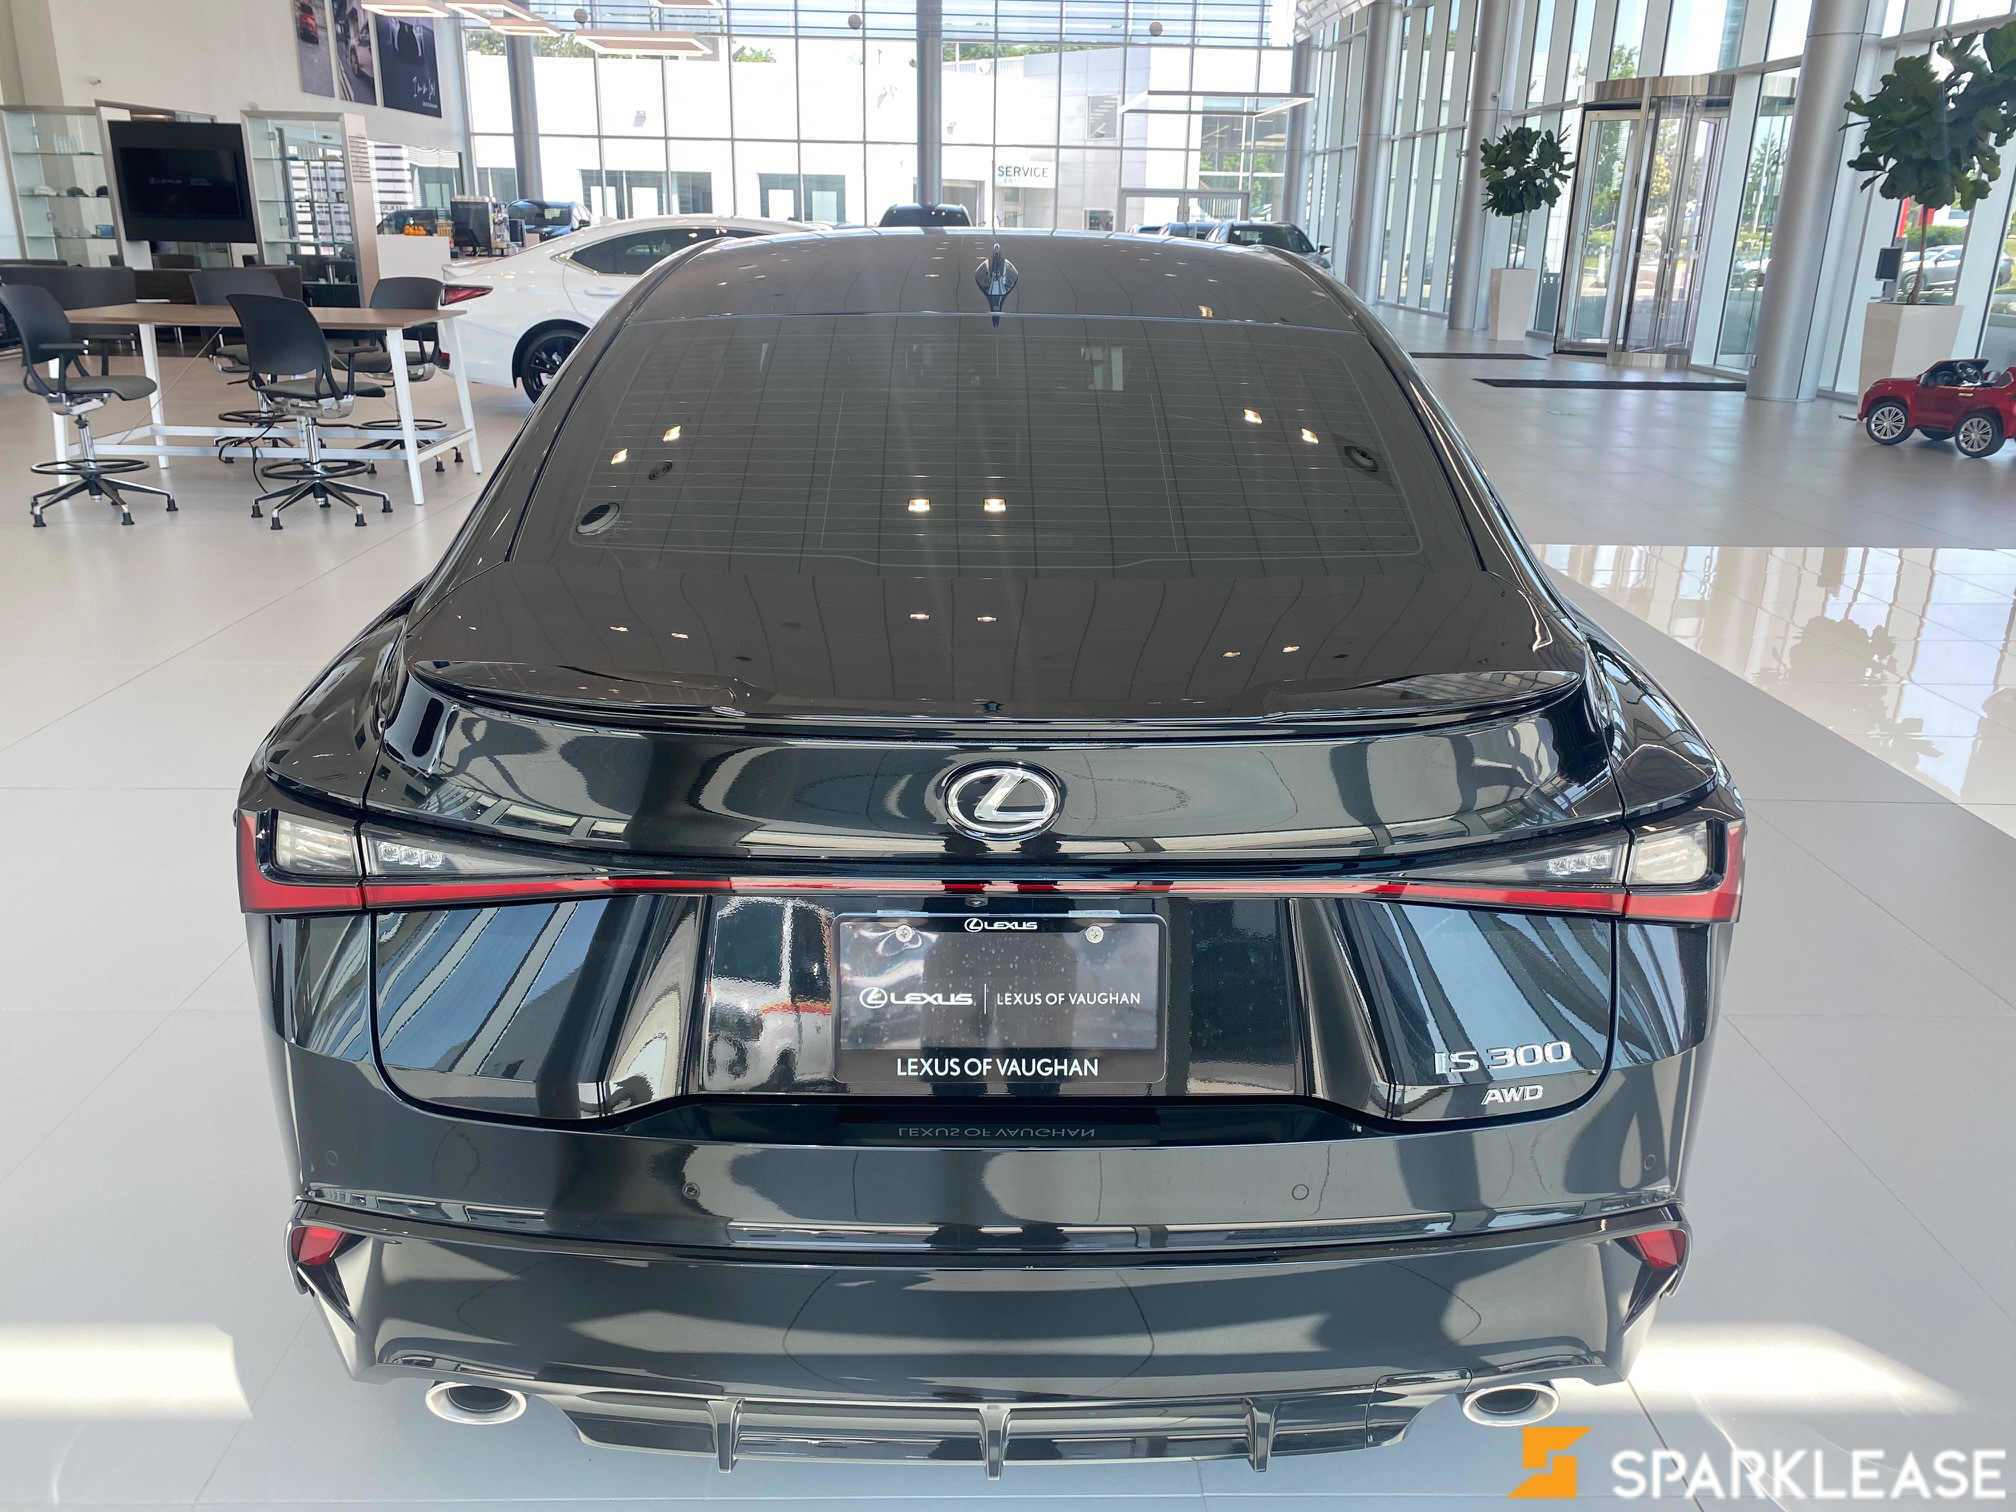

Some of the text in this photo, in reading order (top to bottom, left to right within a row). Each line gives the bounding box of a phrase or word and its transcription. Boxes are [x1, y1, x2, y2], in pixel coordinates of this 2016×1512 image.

[997, 165, 1049, 178] SERVICE
[983, 921, 1038, 930] LEXUS
[890, 992, 974, 1006] LEXUS
[996, 992, 1141, 1006] LEXUS OF VAUGHAN
[1434, 1040, 1573, 1075] IS 300
[896, 1057, 1099, 1077] LEXUS OF VAUGHAN
[1480, 1084, 1544, 1105] AWD
